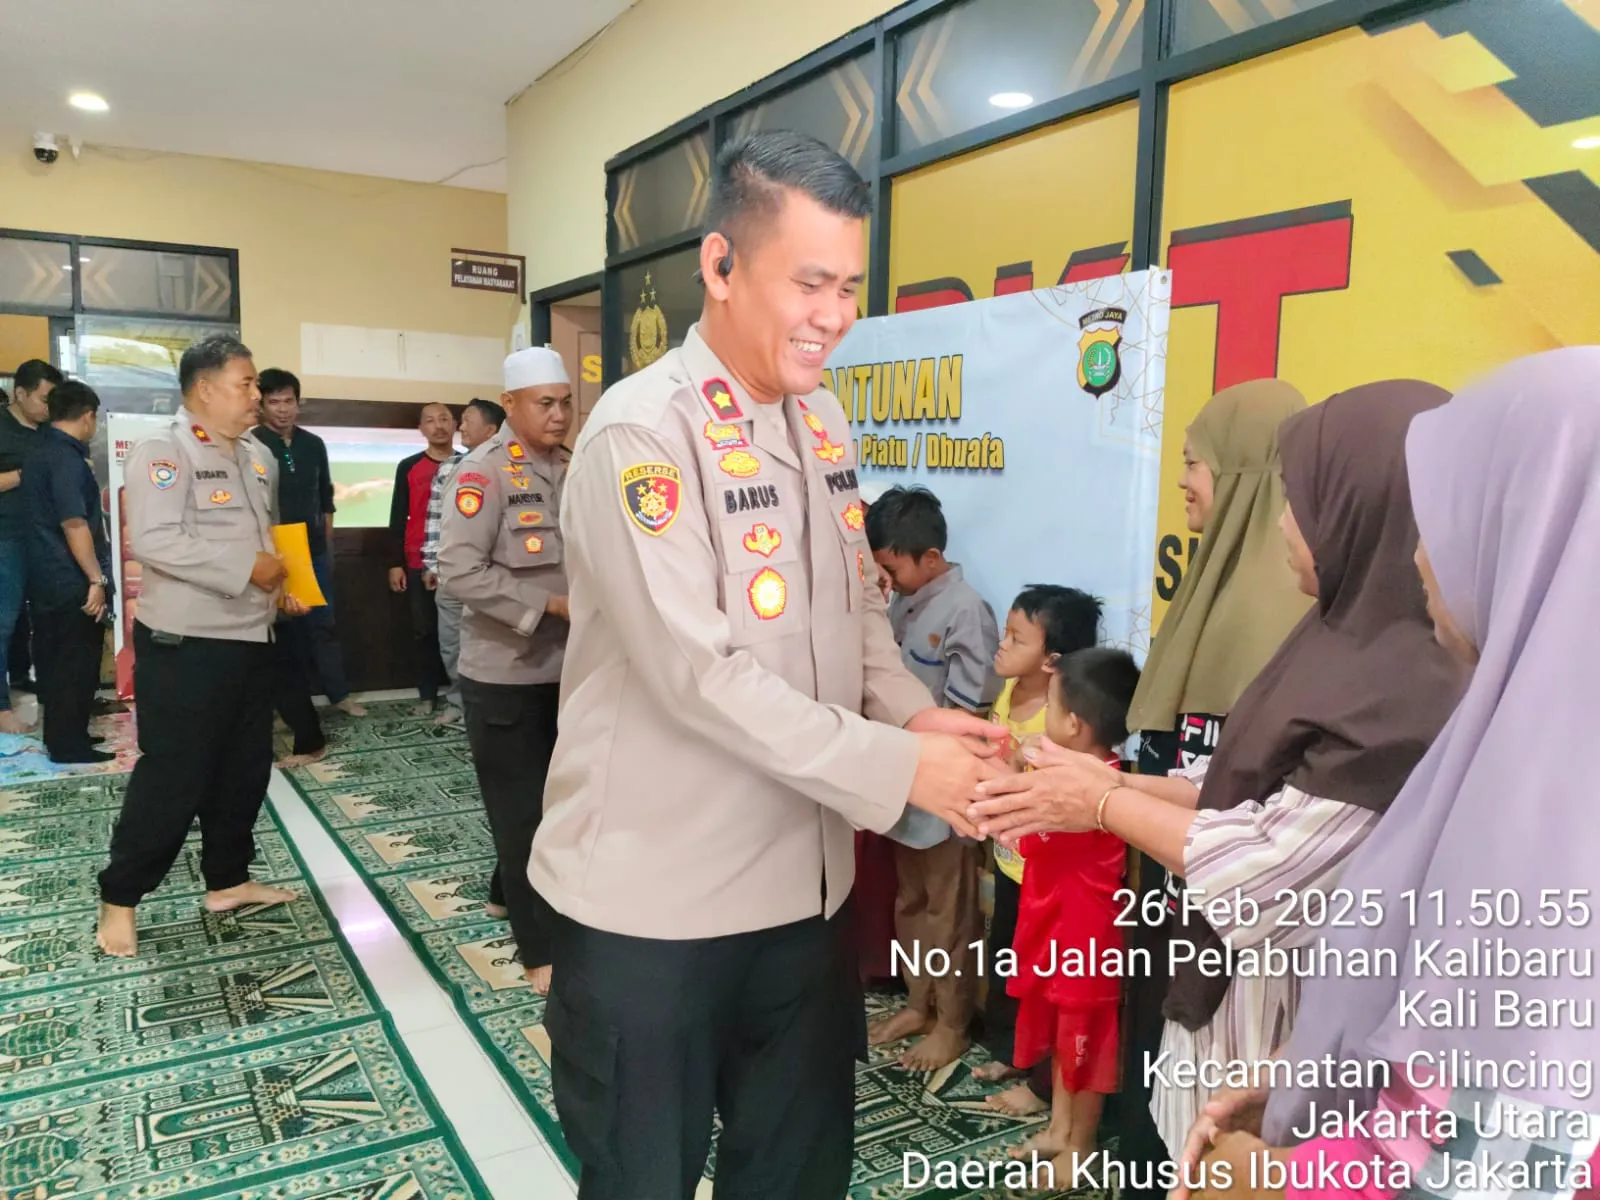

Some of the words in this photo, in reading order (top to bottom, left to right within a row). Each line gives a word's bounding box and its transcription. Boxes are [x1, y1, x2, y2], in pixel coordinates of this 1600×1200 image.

[471, 265, 498, 277] RUANG
[1081, 312, 1104, 326] METRO
[1105, 310, 1123, 320] JAYA
[861, 433, 908, 468] Piatu
[926, 431, 1005, 470] Dhuafa
[624, 465, 679, 482] RESERSE
[724, 484, 779, 514] BARUS
